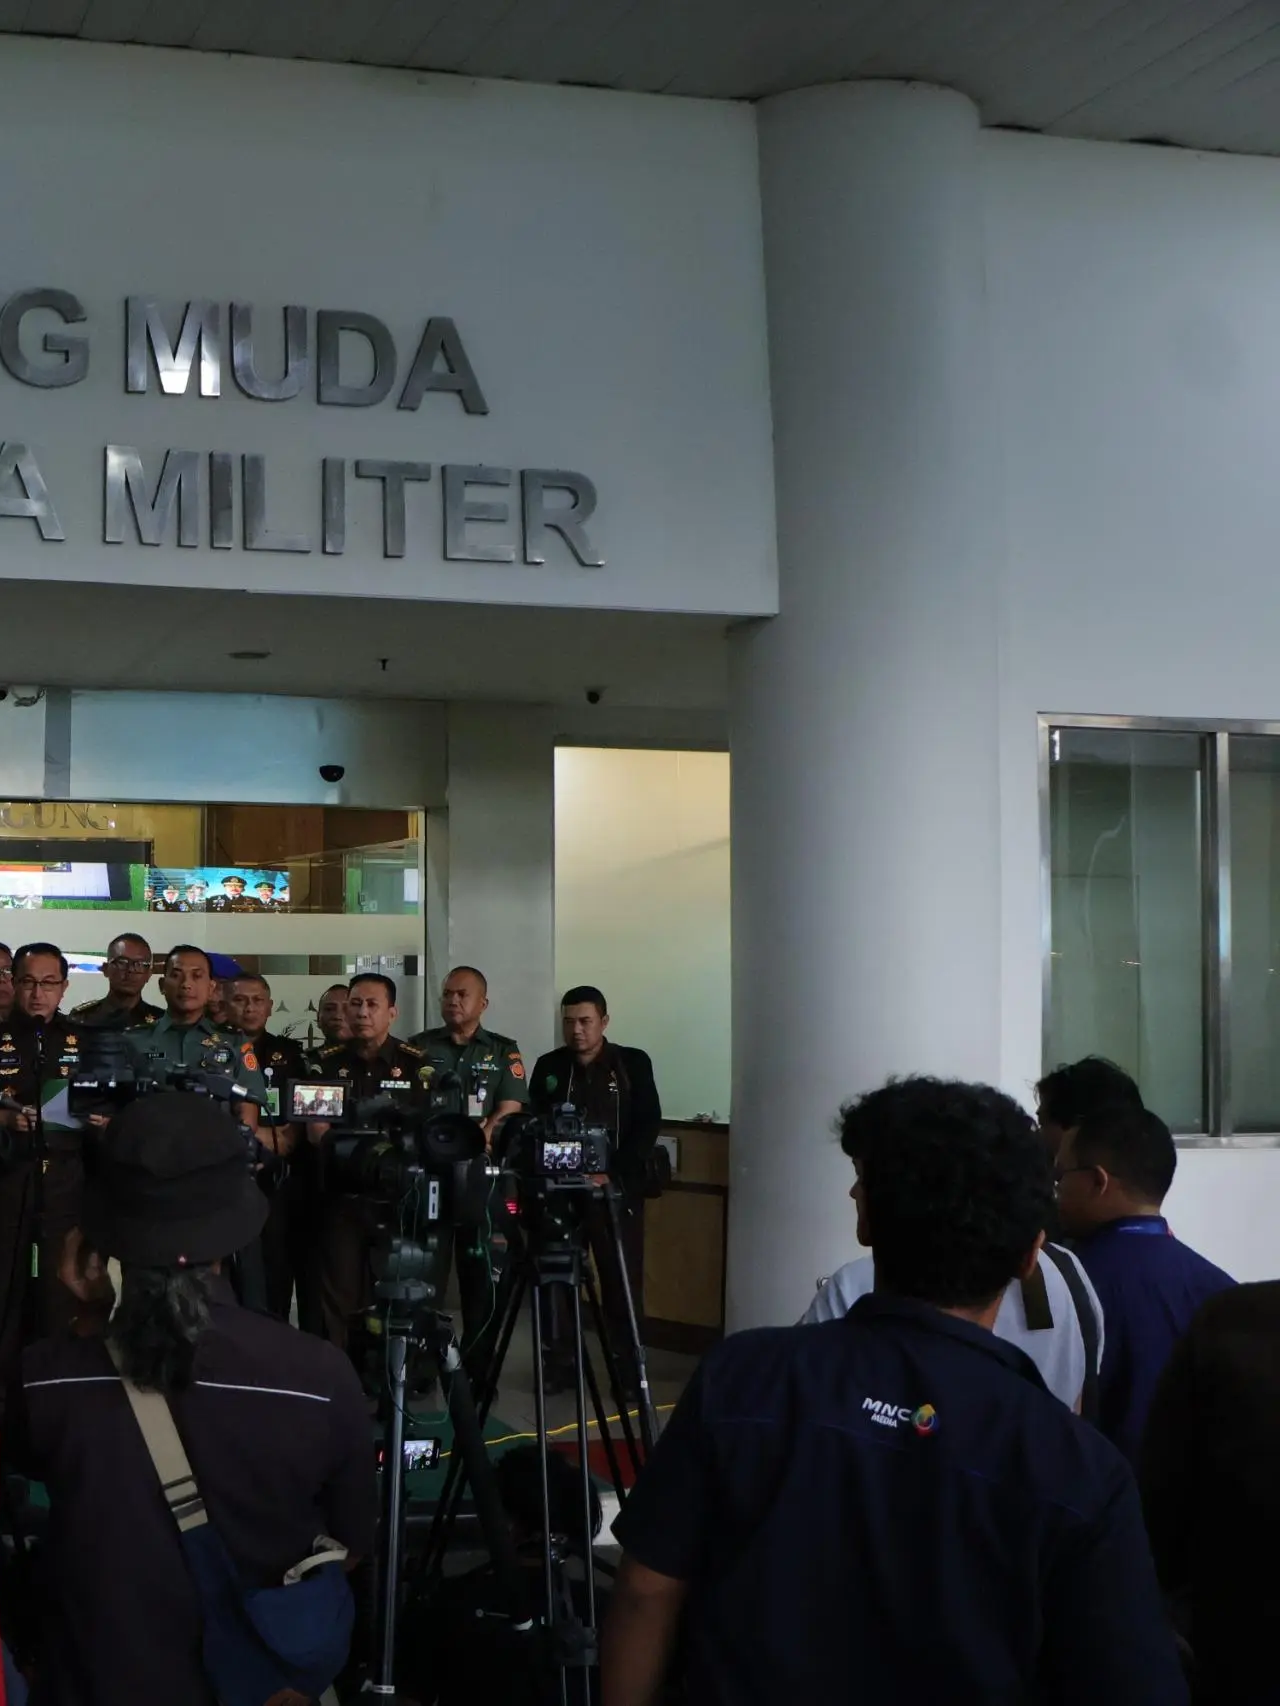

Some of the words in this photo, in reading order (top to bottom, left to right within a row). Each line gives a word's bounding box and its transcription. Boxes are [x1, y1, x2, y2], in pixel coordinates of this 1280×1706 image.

[125, 295, 489, 416] MUDA
[104, 444, 606, 568] MILITER
[862, 1397, 913, 1422] MNC
[870, 1412, 898, 1428] MEDIA
